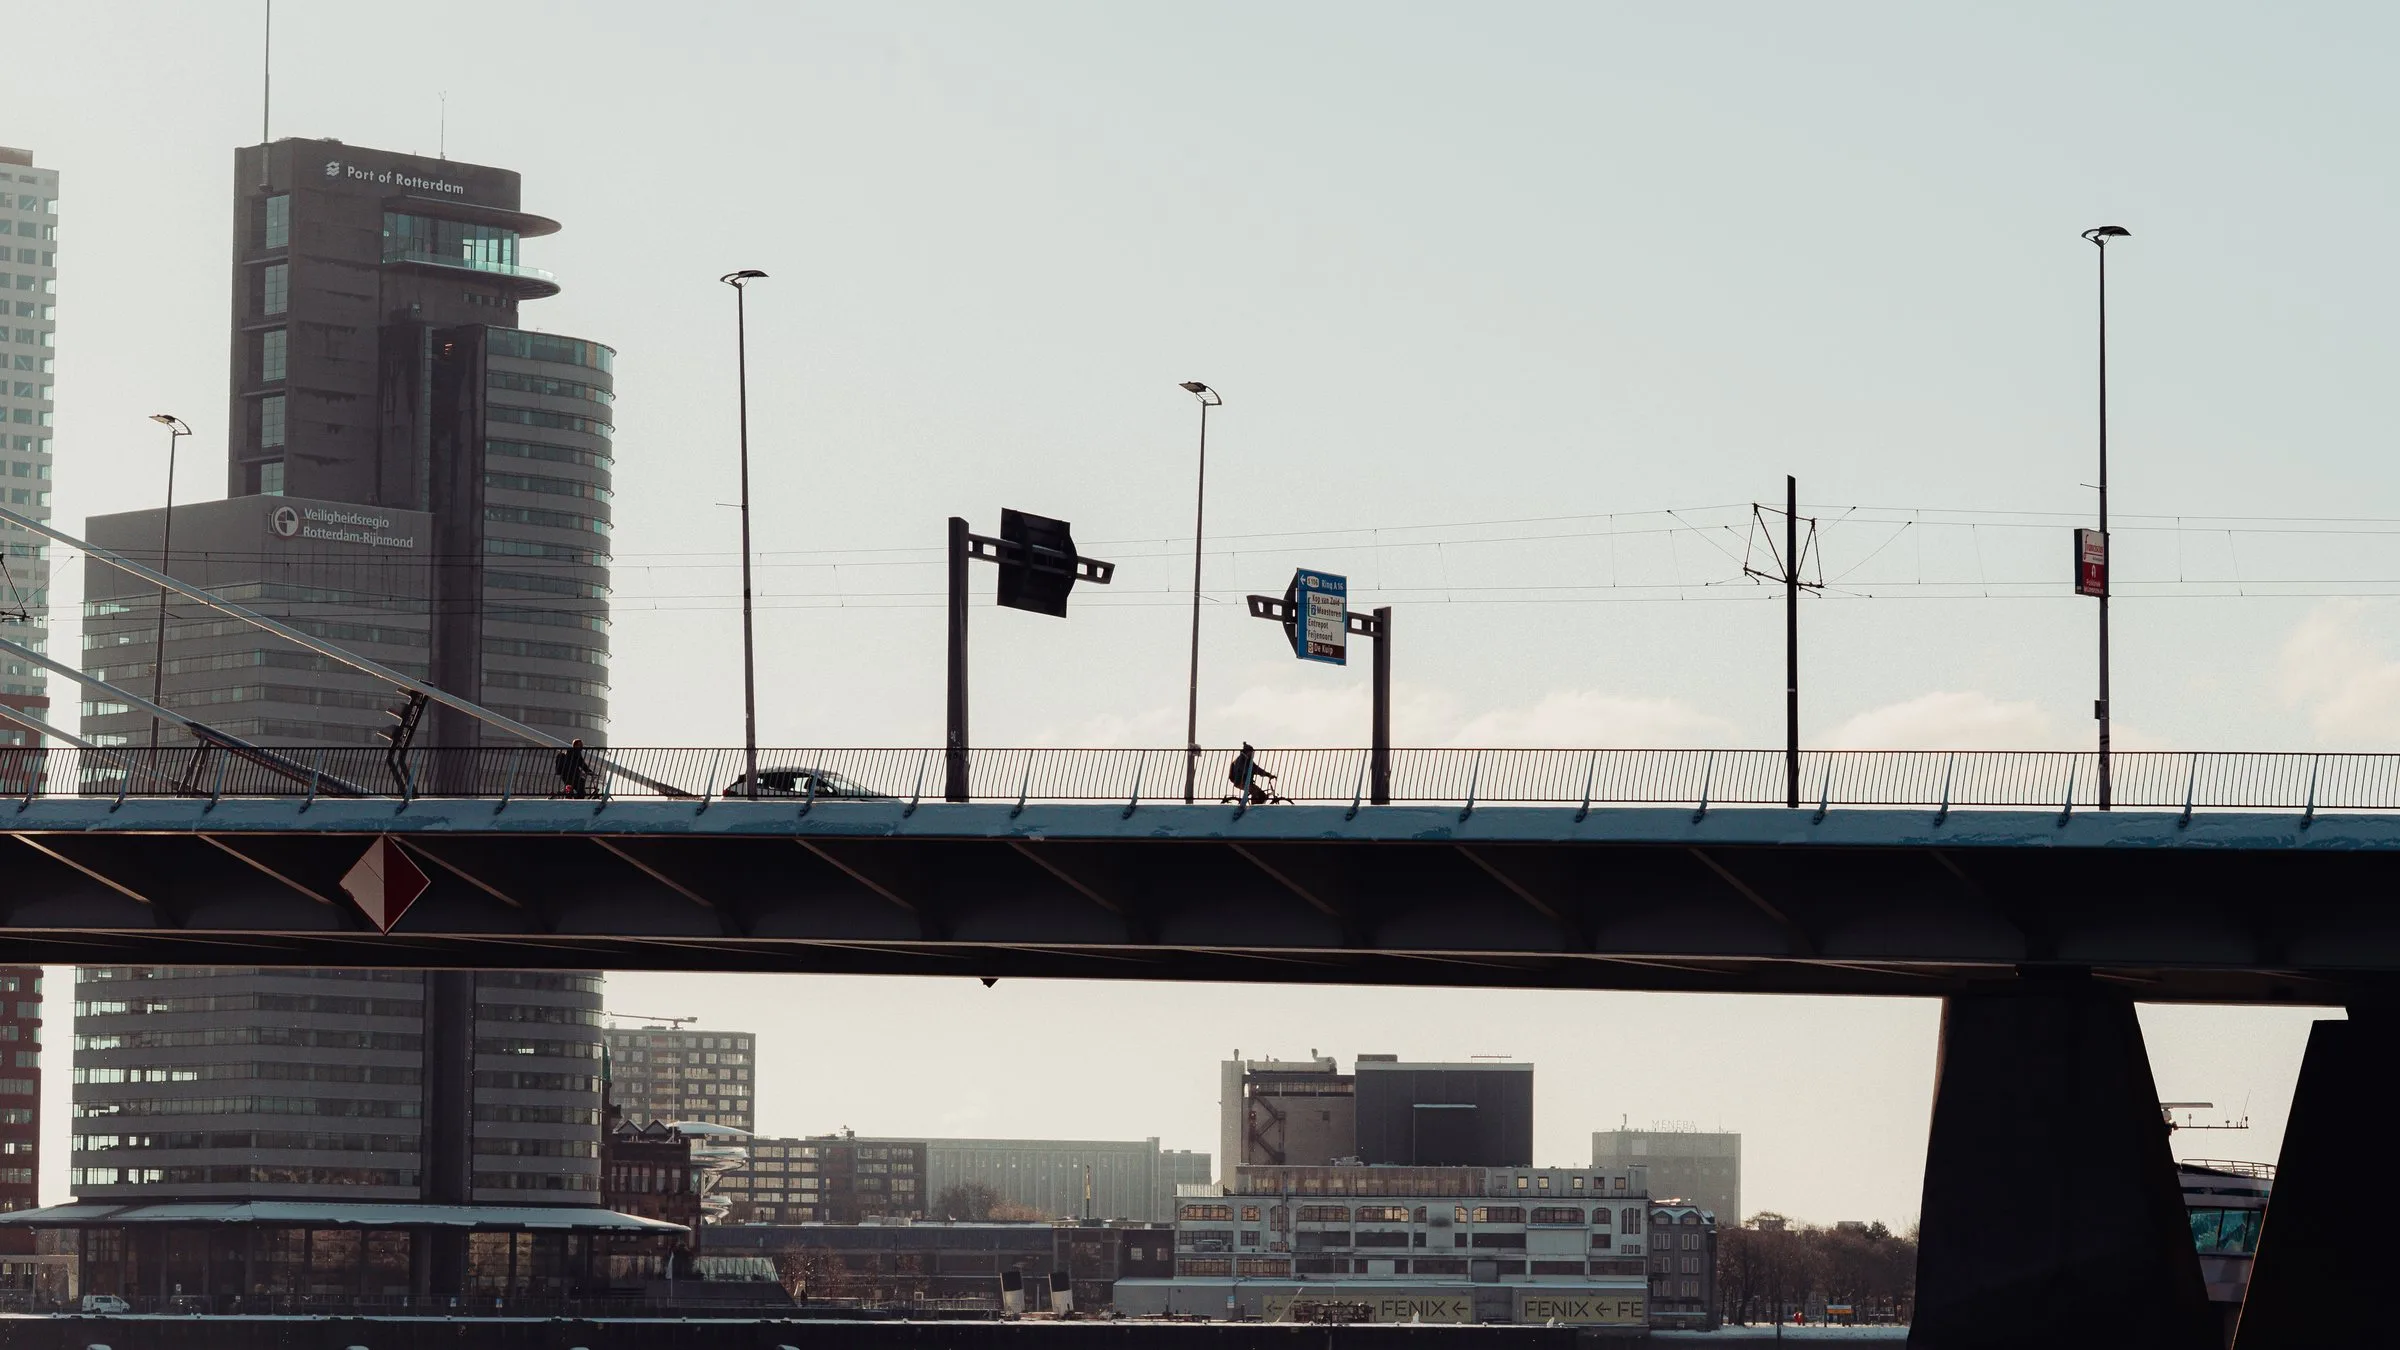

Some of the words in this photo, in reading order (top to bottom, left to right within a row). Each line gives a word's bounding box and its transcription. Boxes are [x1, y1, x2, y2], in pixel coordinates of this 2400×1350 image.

[347, 166, 375, 181] Port
[378, 171, 392, 184] of
[396, 173, 464, 194] Rotterdam
[304, 508, 389, 528] Veiligheidsregio
[303, 527, 413, 547] Rotterdam-Rijnmond
[1322, 579, 1333, 590] Ring
[1312, 594, 1320, 604] Kop
[1308, 618, 1329, 630] Entrepot
[1322, 644, 1334, 656] Kuip
[1381, 1299, 1447, 1317] FENIX
[1524, 1299, 1589, 1318] FENIX
[1616, 1300, 1644, 1318] FE
